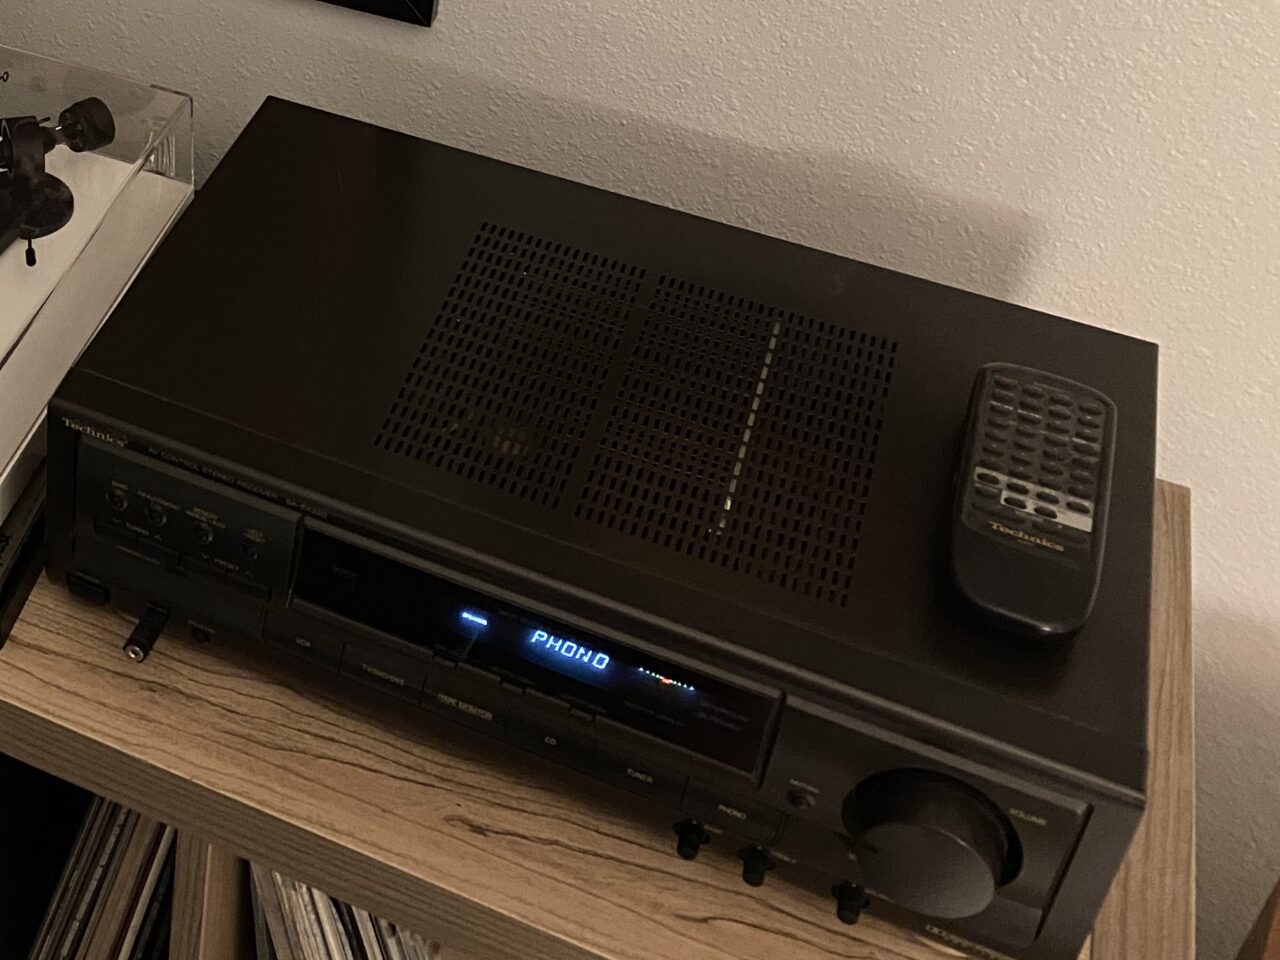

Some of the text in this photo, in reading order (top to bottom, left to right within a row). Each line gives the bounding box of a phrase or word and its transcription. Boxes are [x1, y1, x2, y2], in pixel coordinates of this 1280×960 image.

[62, 417, 128, 449] Technics
[989, 521, 1065, 552] Technics
[529, 628, 611, 671] PHONO
[1008, 807, 1048, 827] VOLUME
